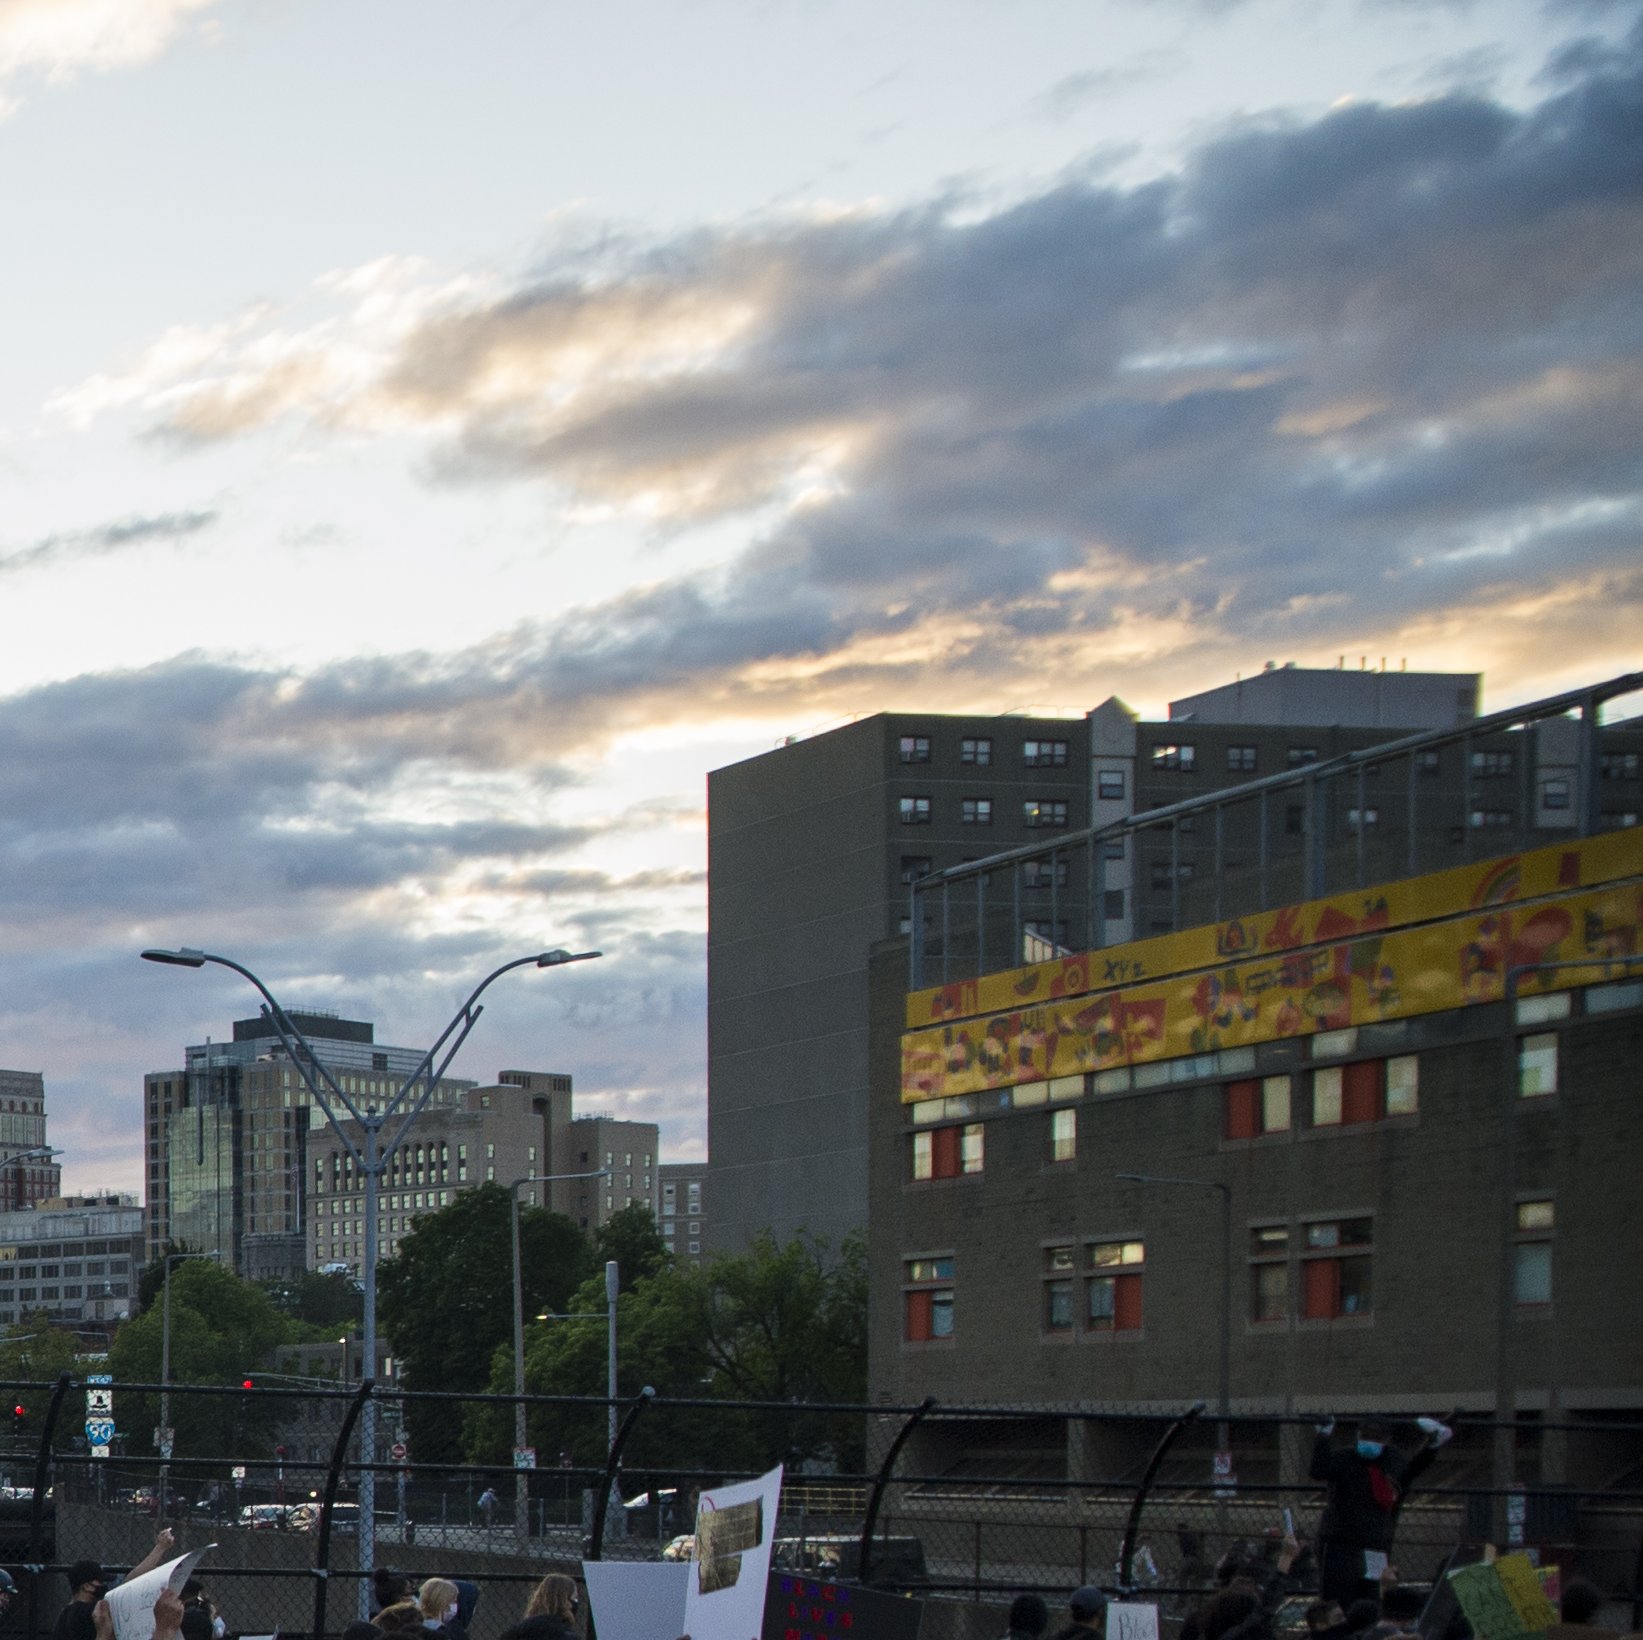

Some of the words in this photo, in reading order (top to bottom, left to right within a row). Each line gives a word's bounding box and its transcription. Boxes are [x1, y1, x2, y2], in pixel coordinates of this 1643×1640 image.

[89, 1425, 111, 1439] 90
[781, 1577, 851, 1605] BLACK
[788, 1603, 853, 1628] LIVES
